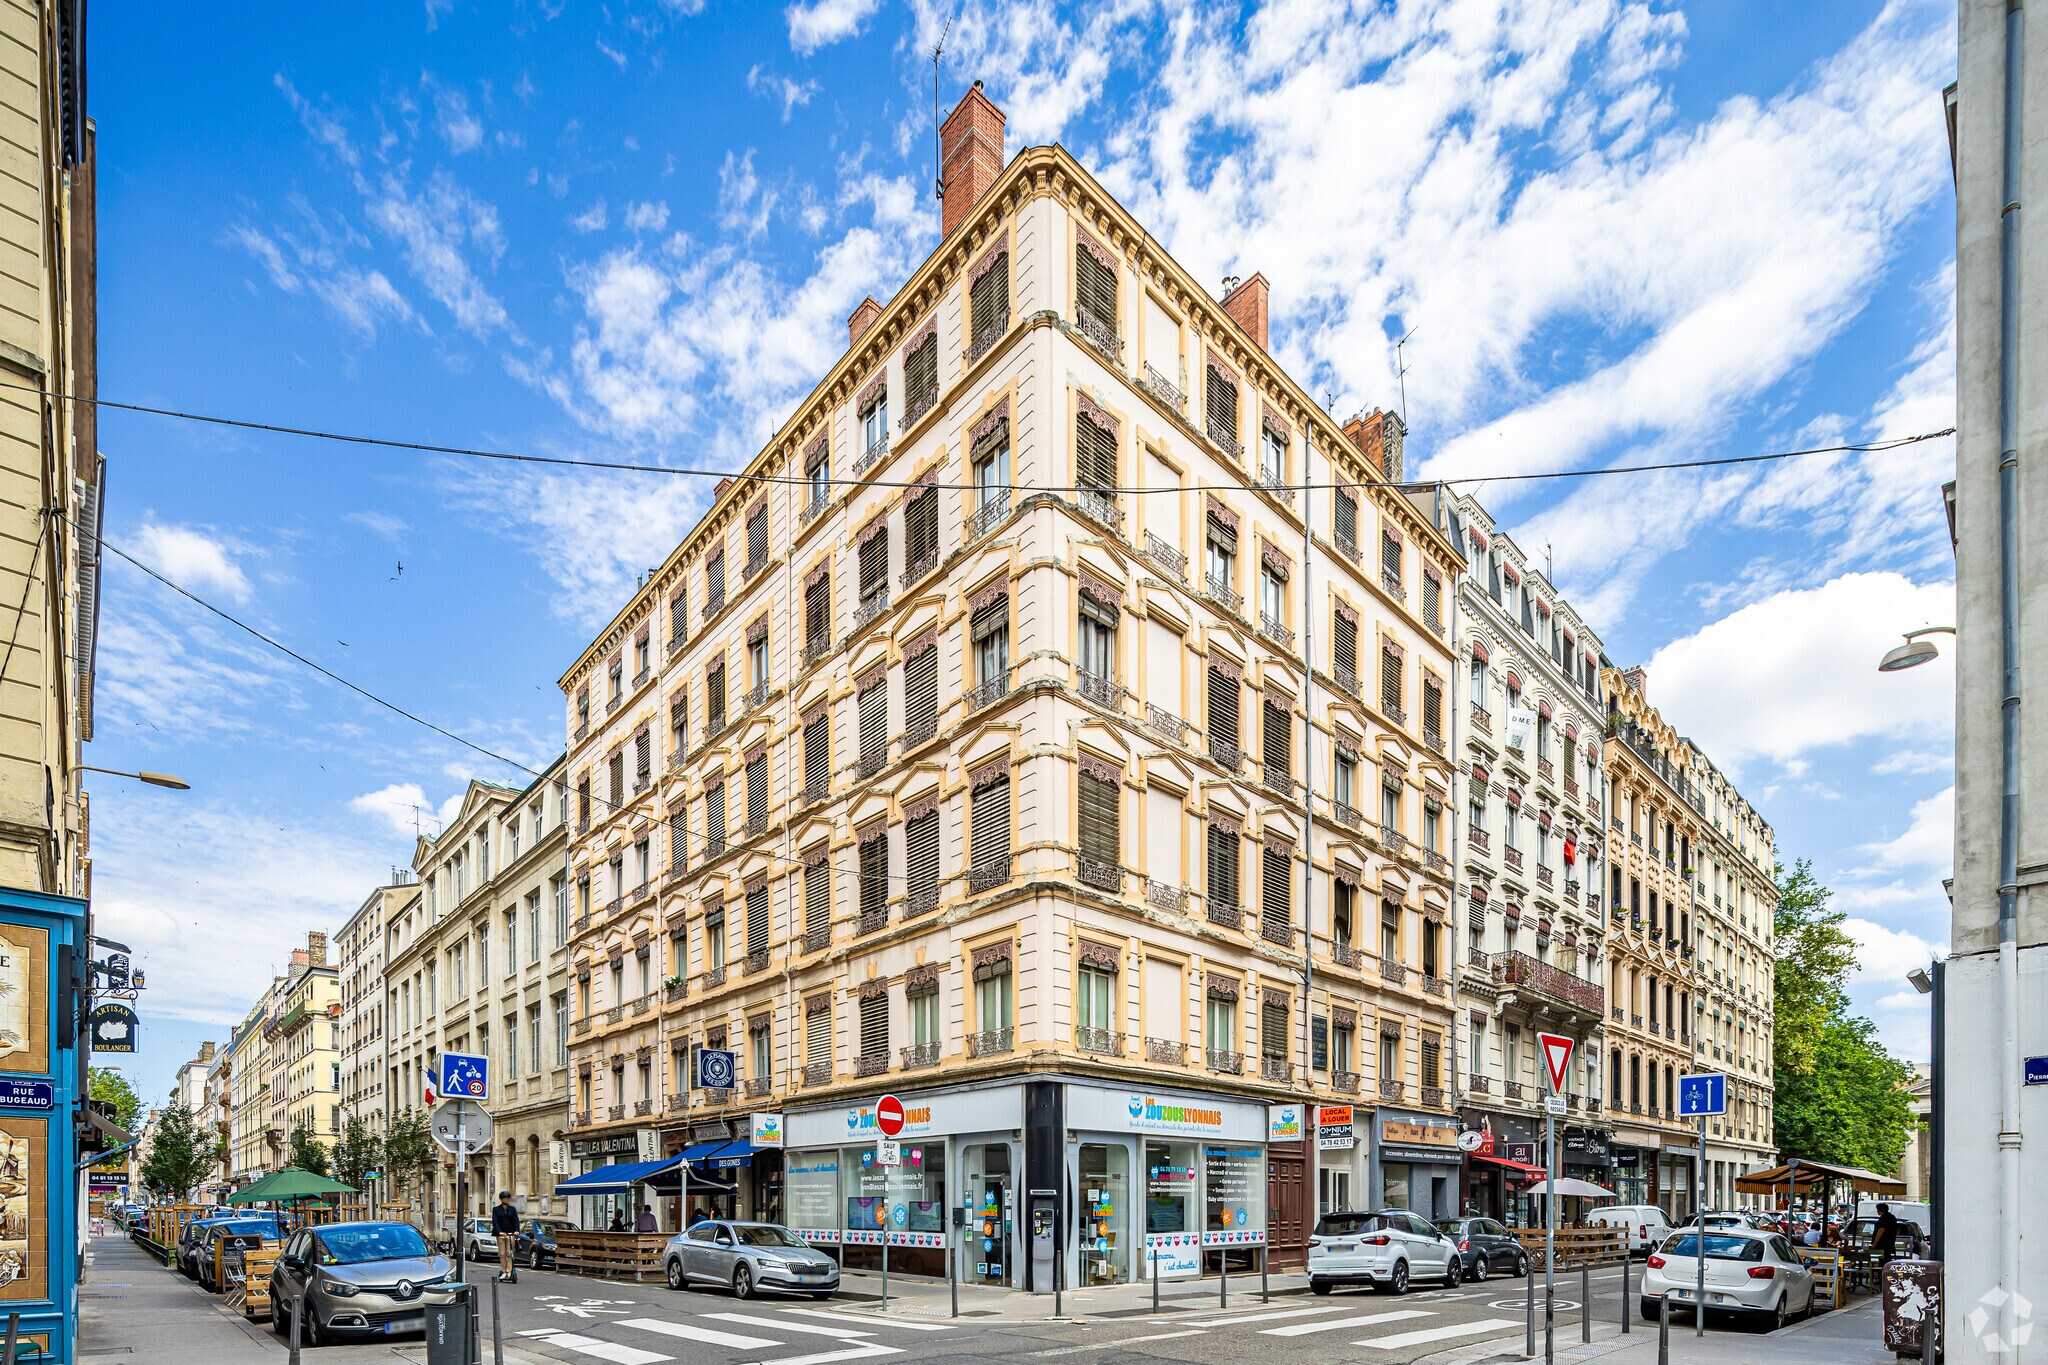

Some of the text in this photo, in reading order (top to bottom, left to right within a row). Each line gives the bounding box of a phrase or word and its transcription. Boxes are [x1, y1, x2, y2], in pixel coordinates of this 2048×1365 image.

[96, 1005, 130, 1017] ARTISAN
[94, 1044, 132, 1052] BOULANGER
[2028, 1073, 2048, 1081] PIERR
[13, 1088, 35, 1096] RUE
[0, 1096, 48, 1105] BUGEAUD
[1325, 1108, 1346, 1116] LOCAL
[1320, 1125, 1352, 1135] OMNIUM
[588, 1142, 600, 1154] LEA
[600, 1137, 636, 1152] VALENTINA
[883, 1142, 896, 1150] SAUF
[1589, 1139, 1606, 1154] Store
